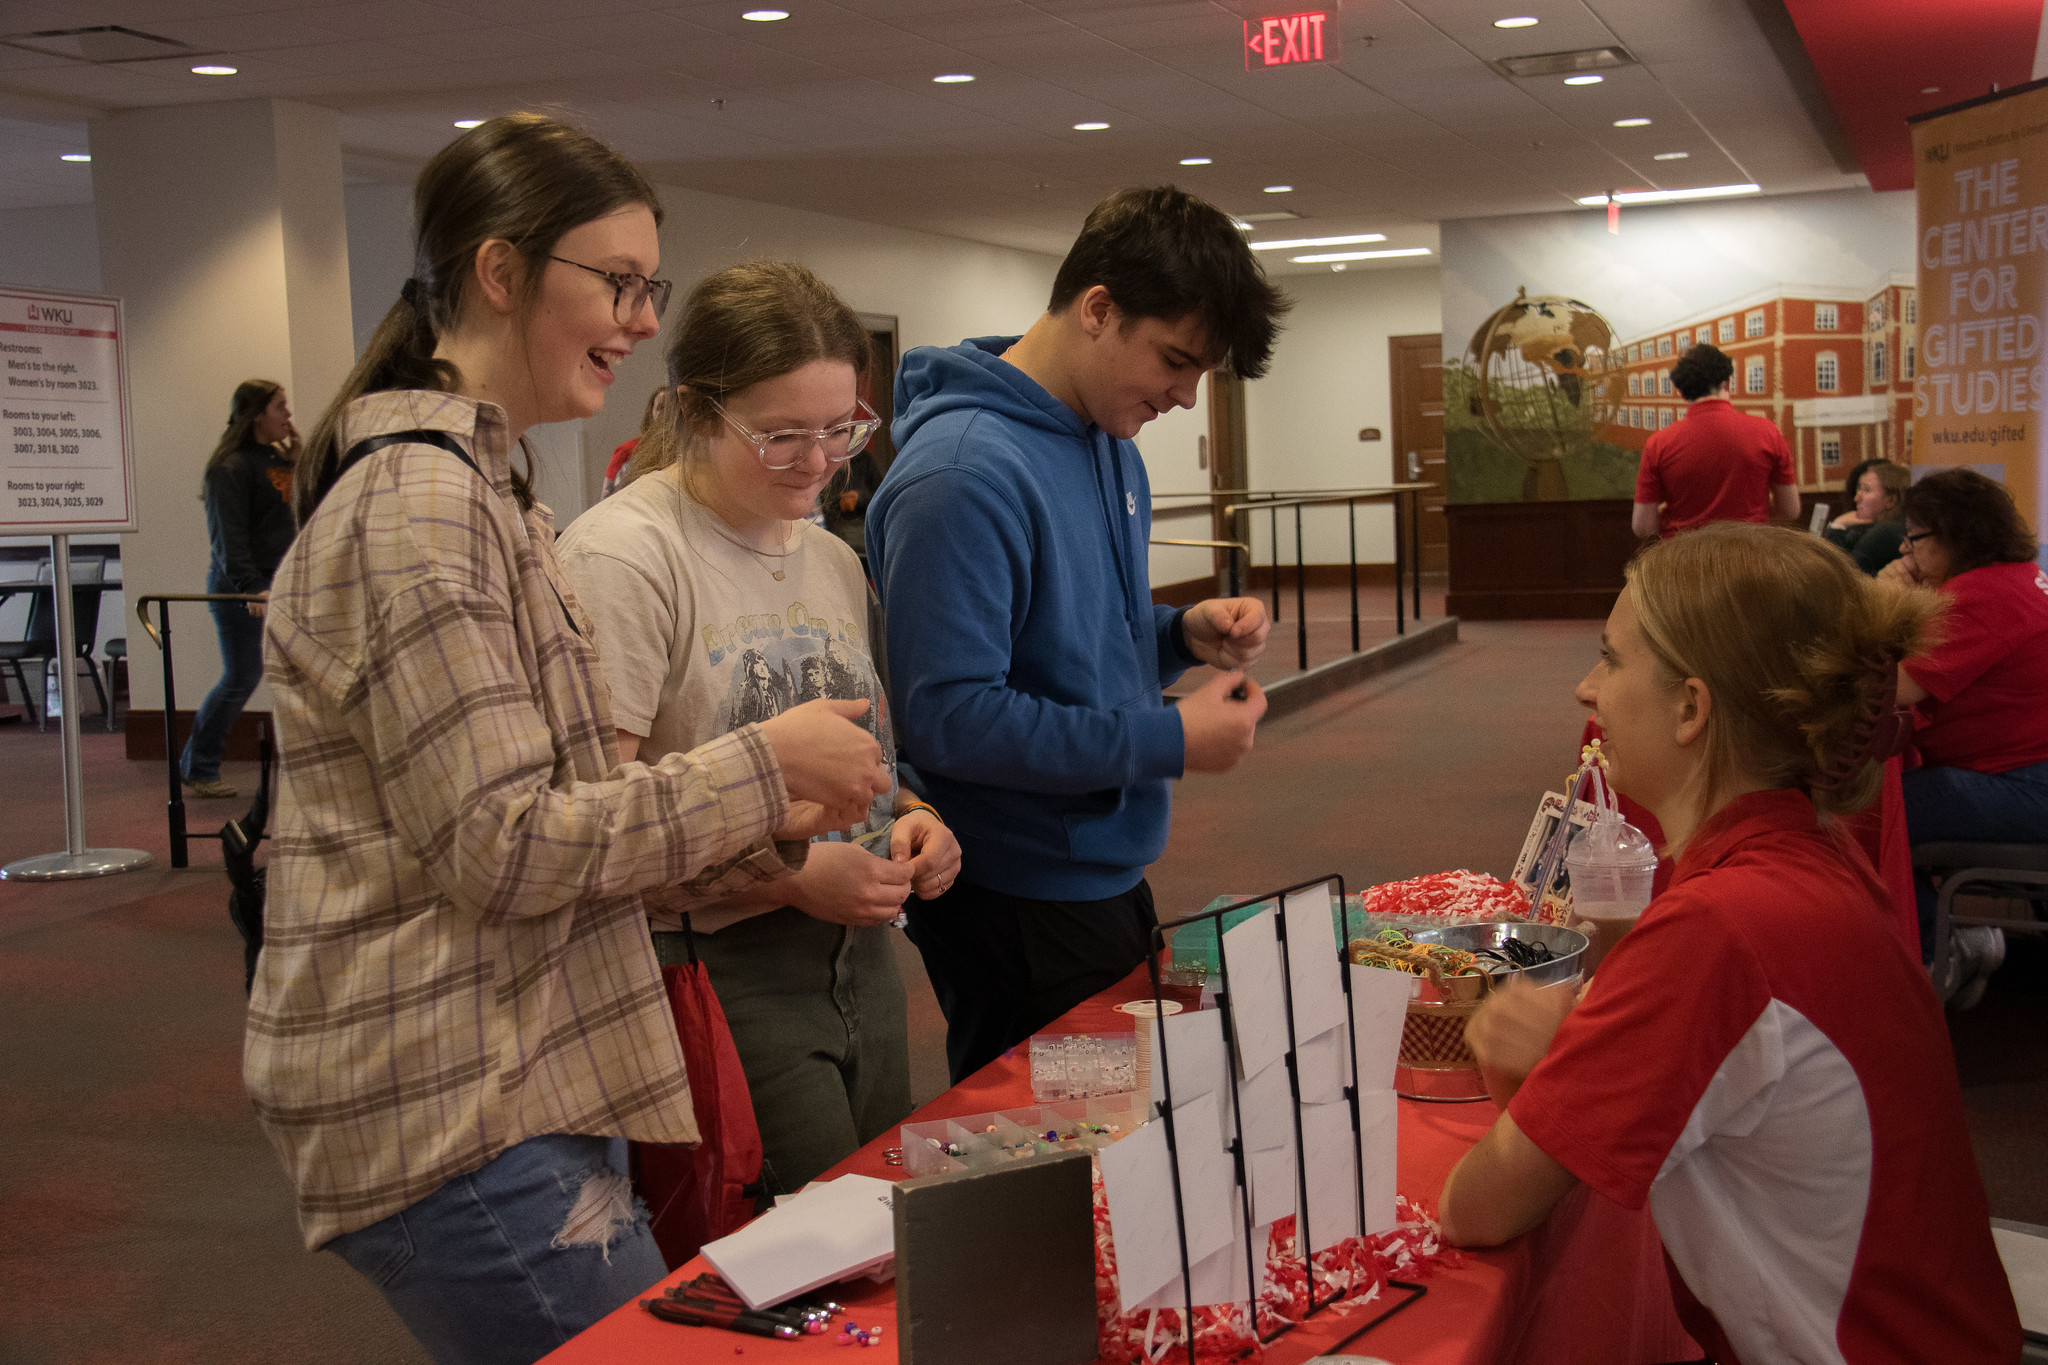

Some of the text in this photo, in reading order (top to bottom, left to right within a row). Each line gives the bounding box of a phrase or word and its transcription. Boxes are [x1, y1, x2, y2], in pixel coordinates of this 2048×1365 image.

[1263, 15, 1326, 66] EXIT
[1954, 158, 2019, 214] THE
[1922, 204, 2048, 270] CENTER
[1950, 264, 2018, 316] FOR
[41, 307, 73, 326] WKU
[1923, 314, 2041, 368] GIFTED
[8, 359, 78, 375] Men's to the right.
[8, 376, 44, 389] Women's
[45, 378, 56, 391] by
[57, 380, 77, 390] room
[1915, 364, 2046, 417] STUDIES
[3, 409, 76, 422] Rooms to your left:
[13, 426, 103, 440] 3003, 3004, 3005, 3006,
[1932, 423, 2025, 447] wku.edu/gifted
[14, 443, 80, 455] 3007, 3018, 3020
[7, 480, 85, 493] Rooms to your right:
[18, 496, 104, 508] 3023, 3024, 3025, 3029
[787, 601, 831, 640] On
